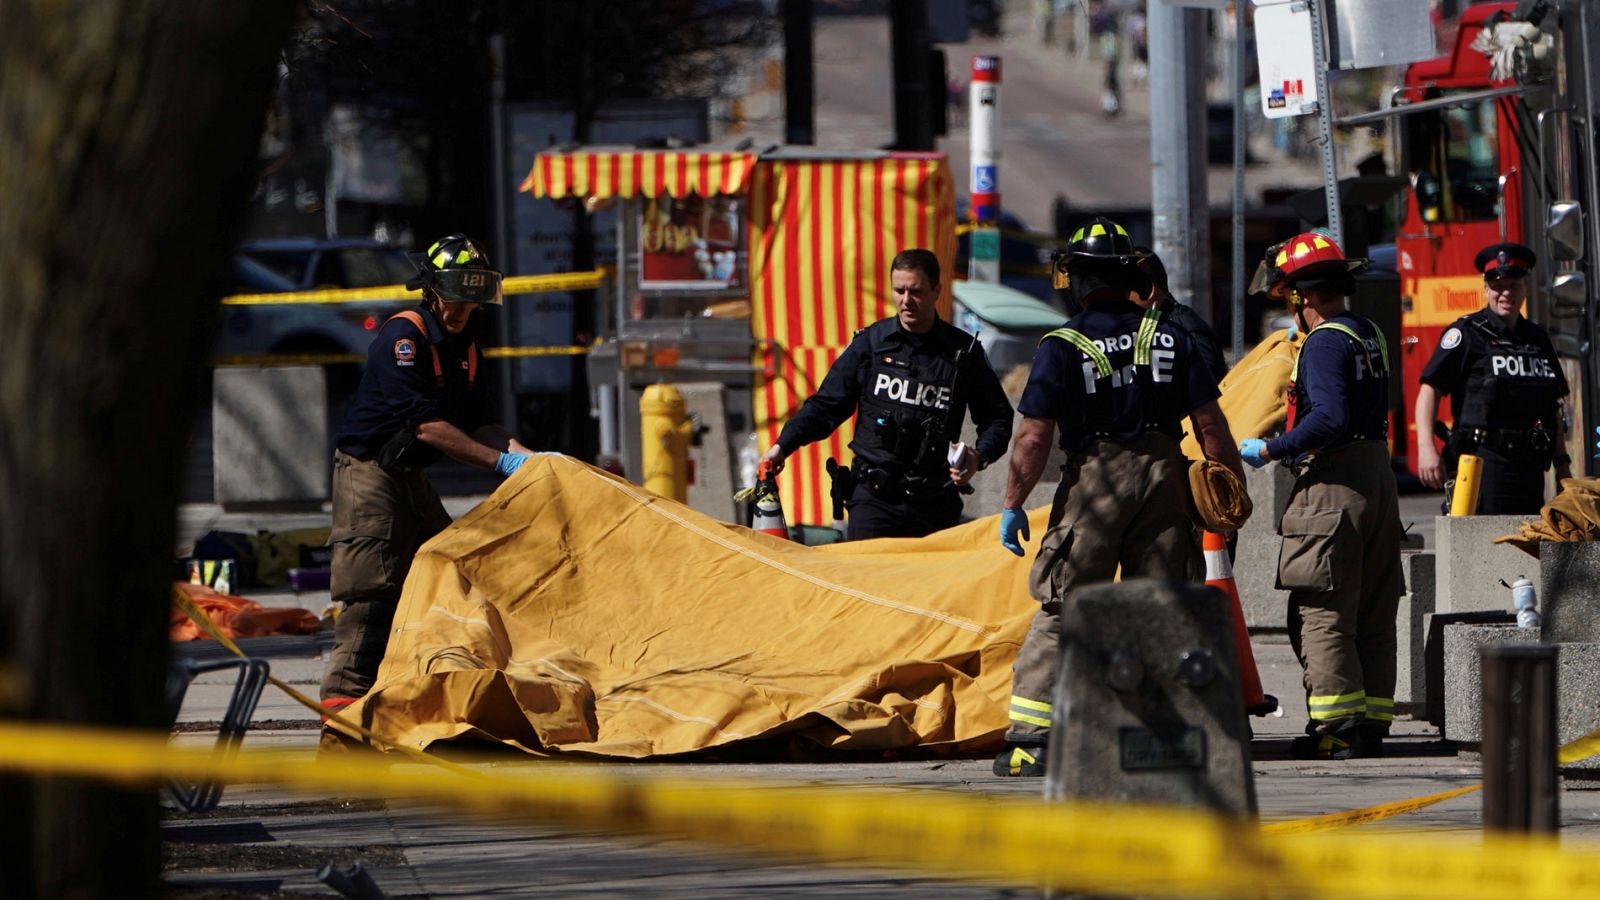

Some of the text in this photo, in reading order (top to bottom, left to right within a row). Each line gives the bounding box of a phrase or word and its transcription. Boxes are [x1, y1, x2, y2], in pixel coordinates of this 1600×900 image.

[1078, 331, 1175, 359] OROTO
[1492, 355, 1556, 378] POLICE
[873, 373, 951, 410] POLICE
